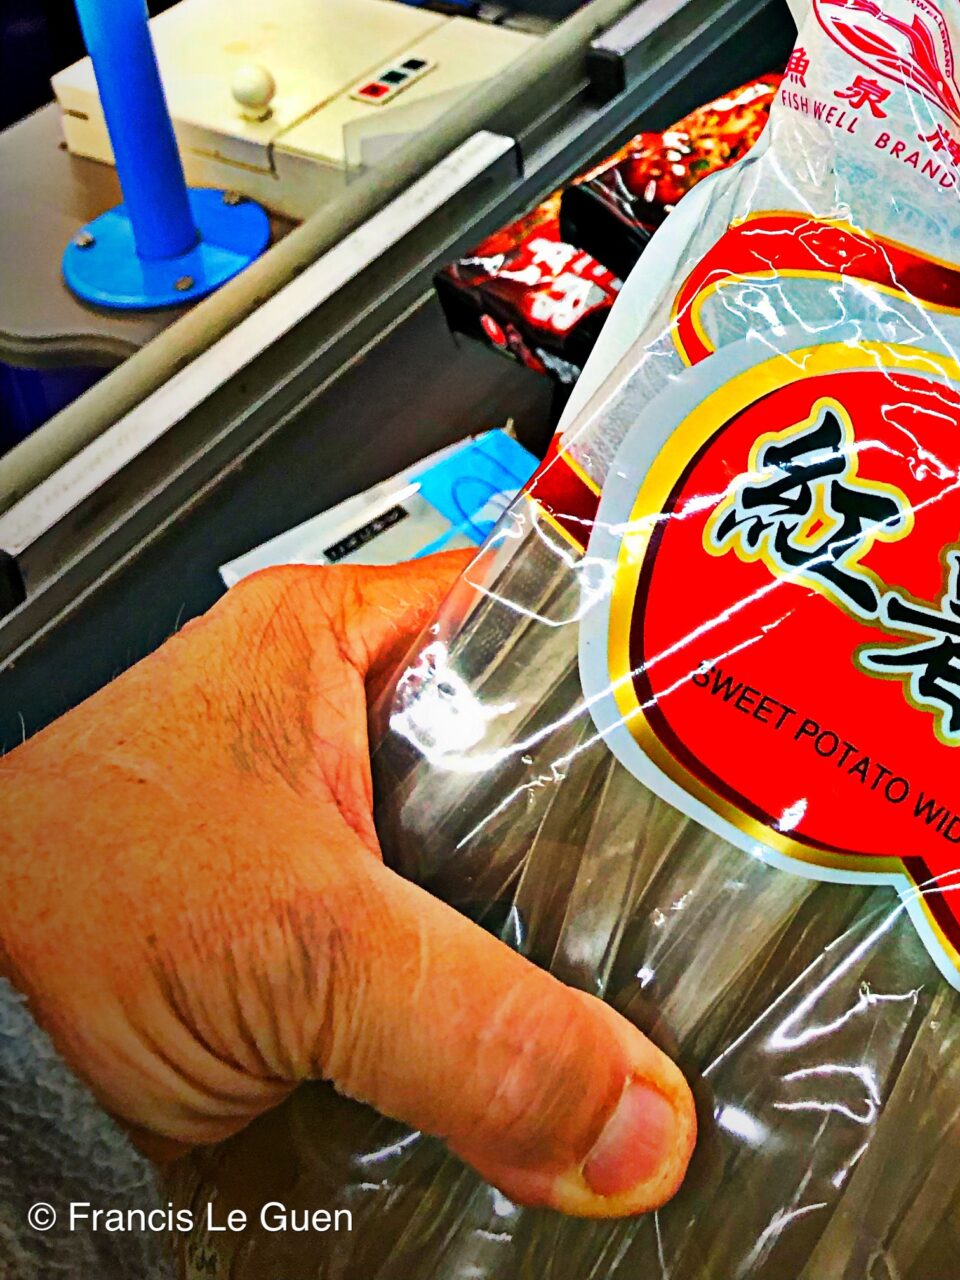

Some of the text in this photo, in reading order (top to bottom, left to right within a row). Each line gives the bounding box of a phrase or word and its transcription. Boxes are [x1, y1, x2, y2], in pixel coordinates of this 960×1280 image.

[781, 89, 957, 188] FISH WELL BRAND
[692, 662, 797, 731] SWEET
[794, 717, 910, 804] POTATO
